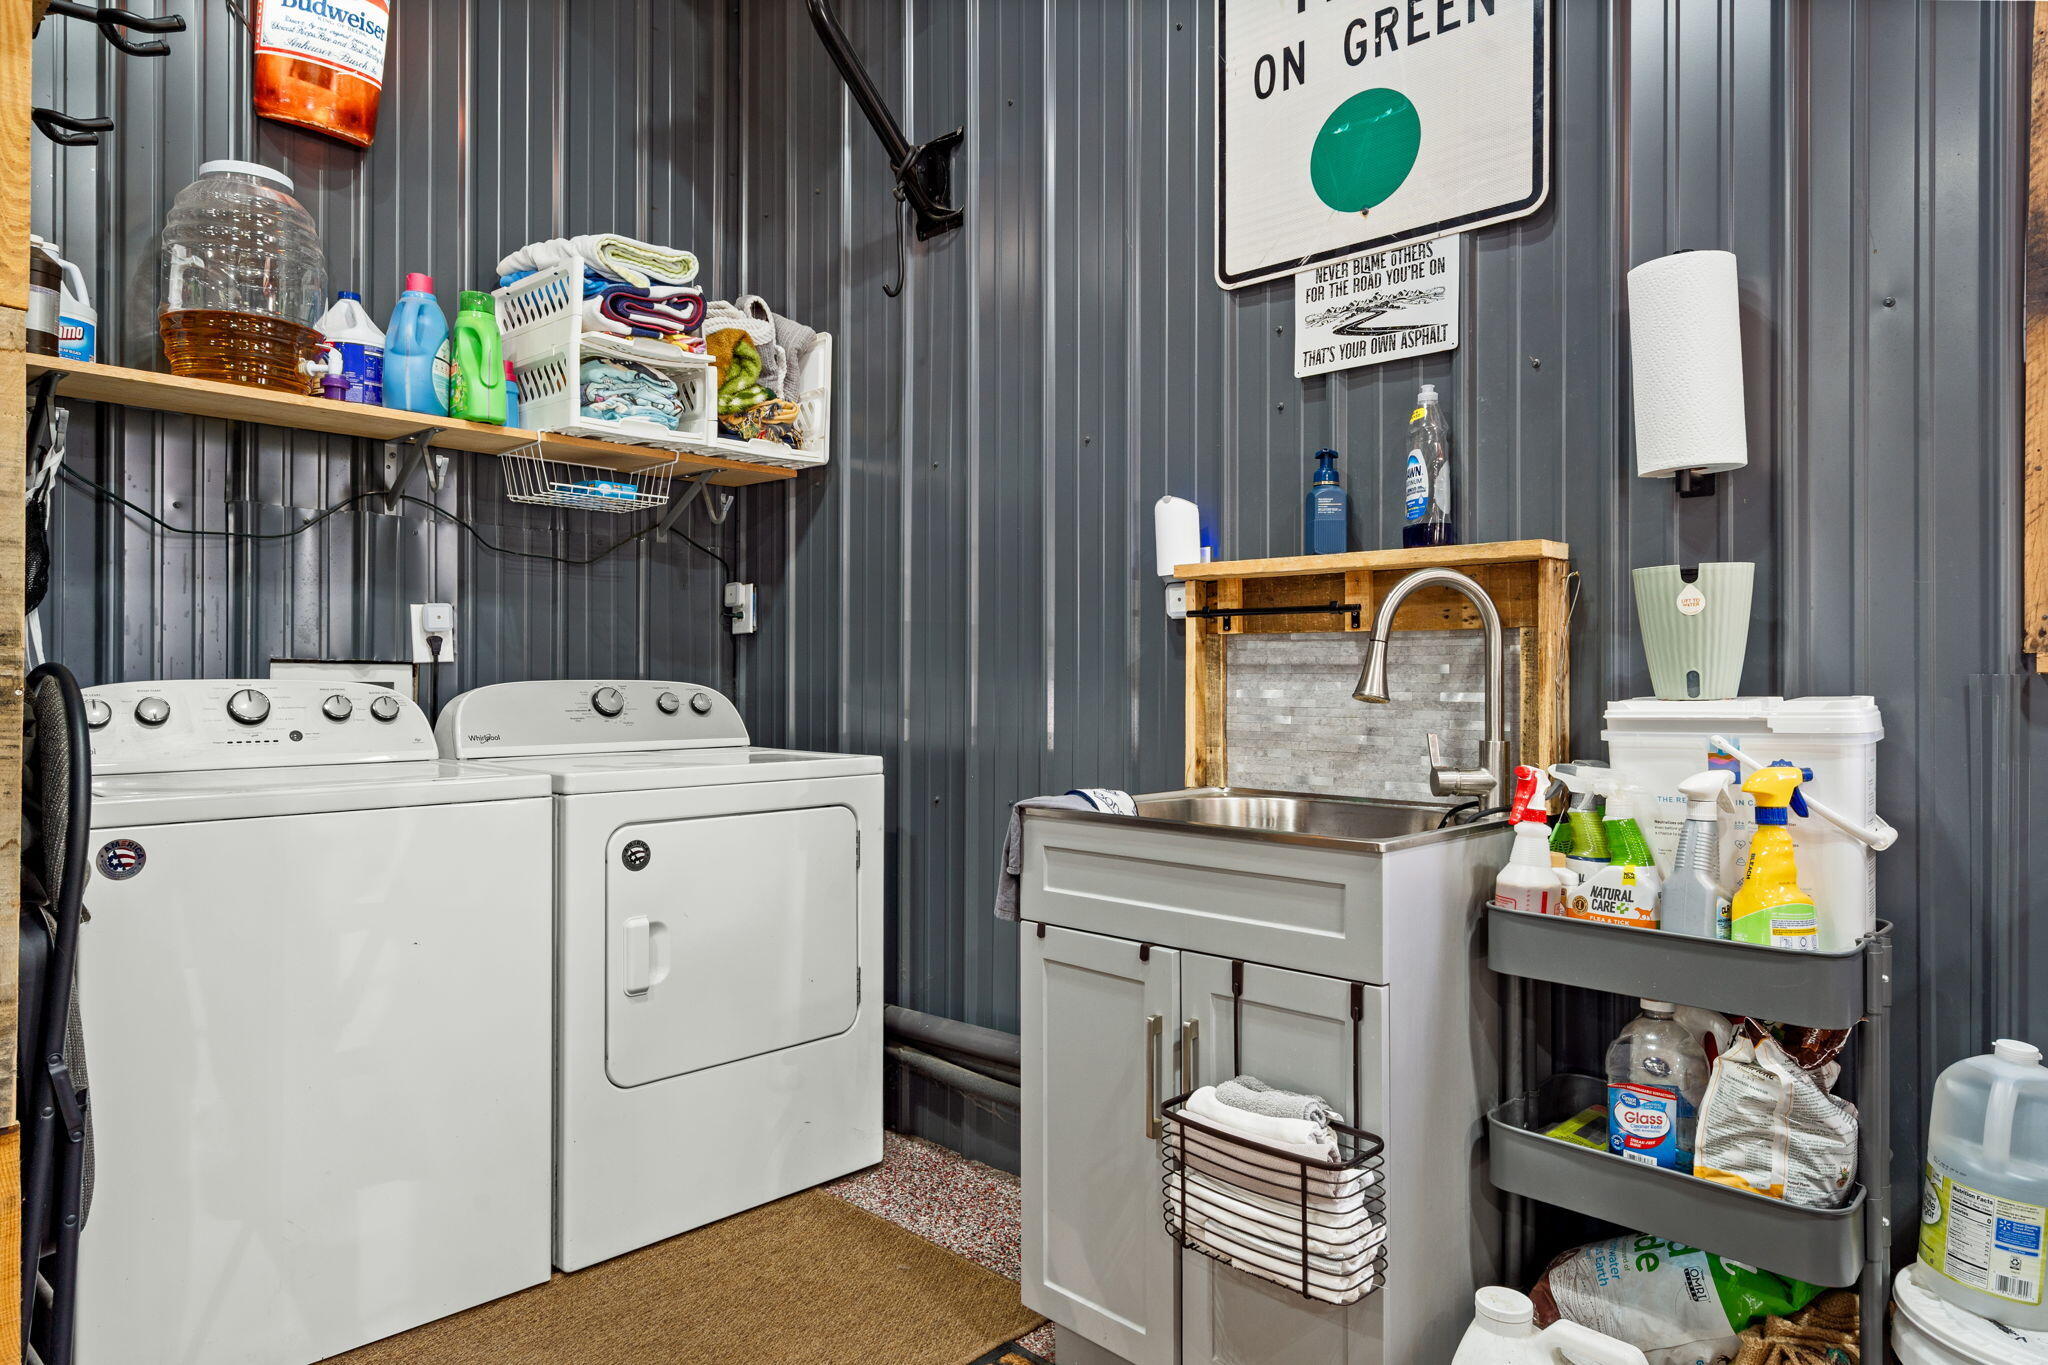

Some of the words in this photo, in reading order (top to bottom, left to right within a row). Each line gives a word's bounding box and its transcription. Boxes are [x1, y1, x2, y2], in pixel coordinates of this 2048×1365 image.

[1254, 40, 1305, 100] ON
[1315, 261, 1348, 284] NEVER
[1353, 251, 1387, 275] BLAME
[1391, 241, 1434, 267] OTHERS
[1305, 285, 1325, 304] FOR
[1329, 279, 1349, 299] THE
[1353, 272, 1382, 293] ROAD
[1386, 261, 1426, 286] YOU'RE
[1429, 256, 1446, 276] ON
[1302, 346, 1335, 368] THAT'S
[1339, 340, 1367, 361] YOUR
[1370, 334, 1397, 355] OWN
[1400, 323, 1449, 350] ASPHALT
[1406, 465, 1422, 480] AWN
[468, 734, 501, 744] Whirlpool
[1657, 795, 1674, 804] THE
[104, 839, 145, 860] AMERICA
[1746, 853, 1756, 880] BLEACH
[1590, 885, 1634, 903] NATURAL
[1591, 898, 1616, 914] CARE
[1589, 915, 1605, 923] FLEA
[1621, 1094, 1637, 1103] Great
[1624, 1111, 1663, 1125] Glass
[1952, 1185, 1976, 1200] Nutrition
[1976, 1194, 1994, 1206] Facts
[1951, 1205, 1969, 1217] Calories
[1595, 1255, 1610, 1288] Earth
[1689, 1268, 1708, 1300] OMRI
